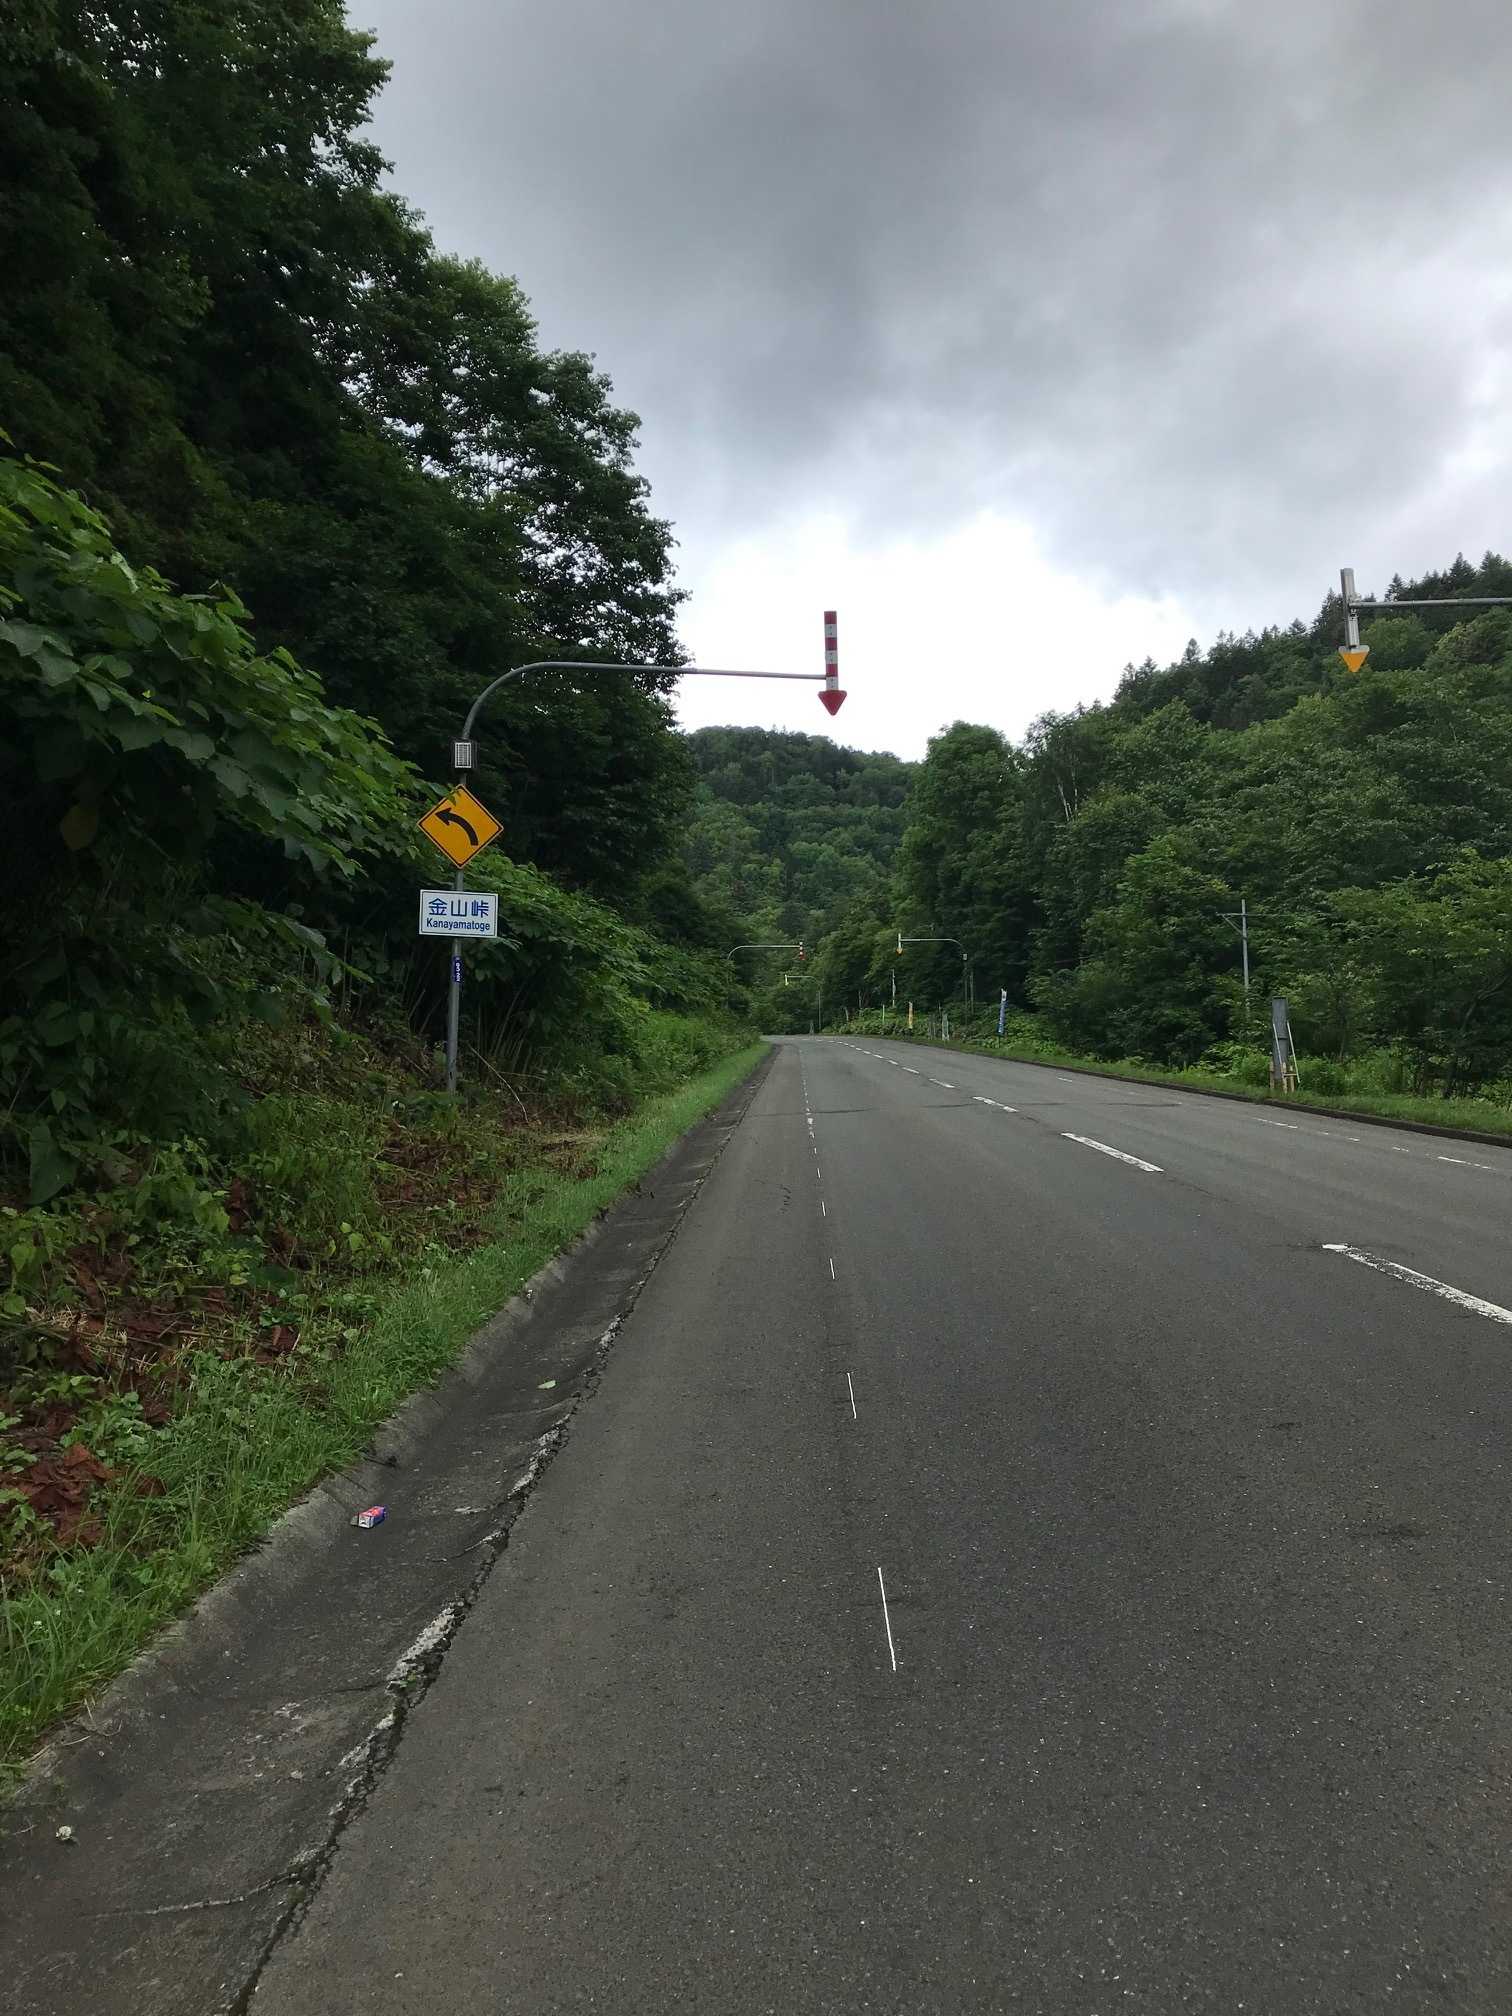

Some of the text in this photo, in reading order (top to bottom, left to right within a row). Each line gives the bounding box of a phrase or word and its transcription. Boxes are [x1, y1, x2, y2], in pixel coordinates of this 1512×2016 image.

[428, 898, 489, 918] 金山峠
[426, 918, 490, 931] Kanayamatoge
